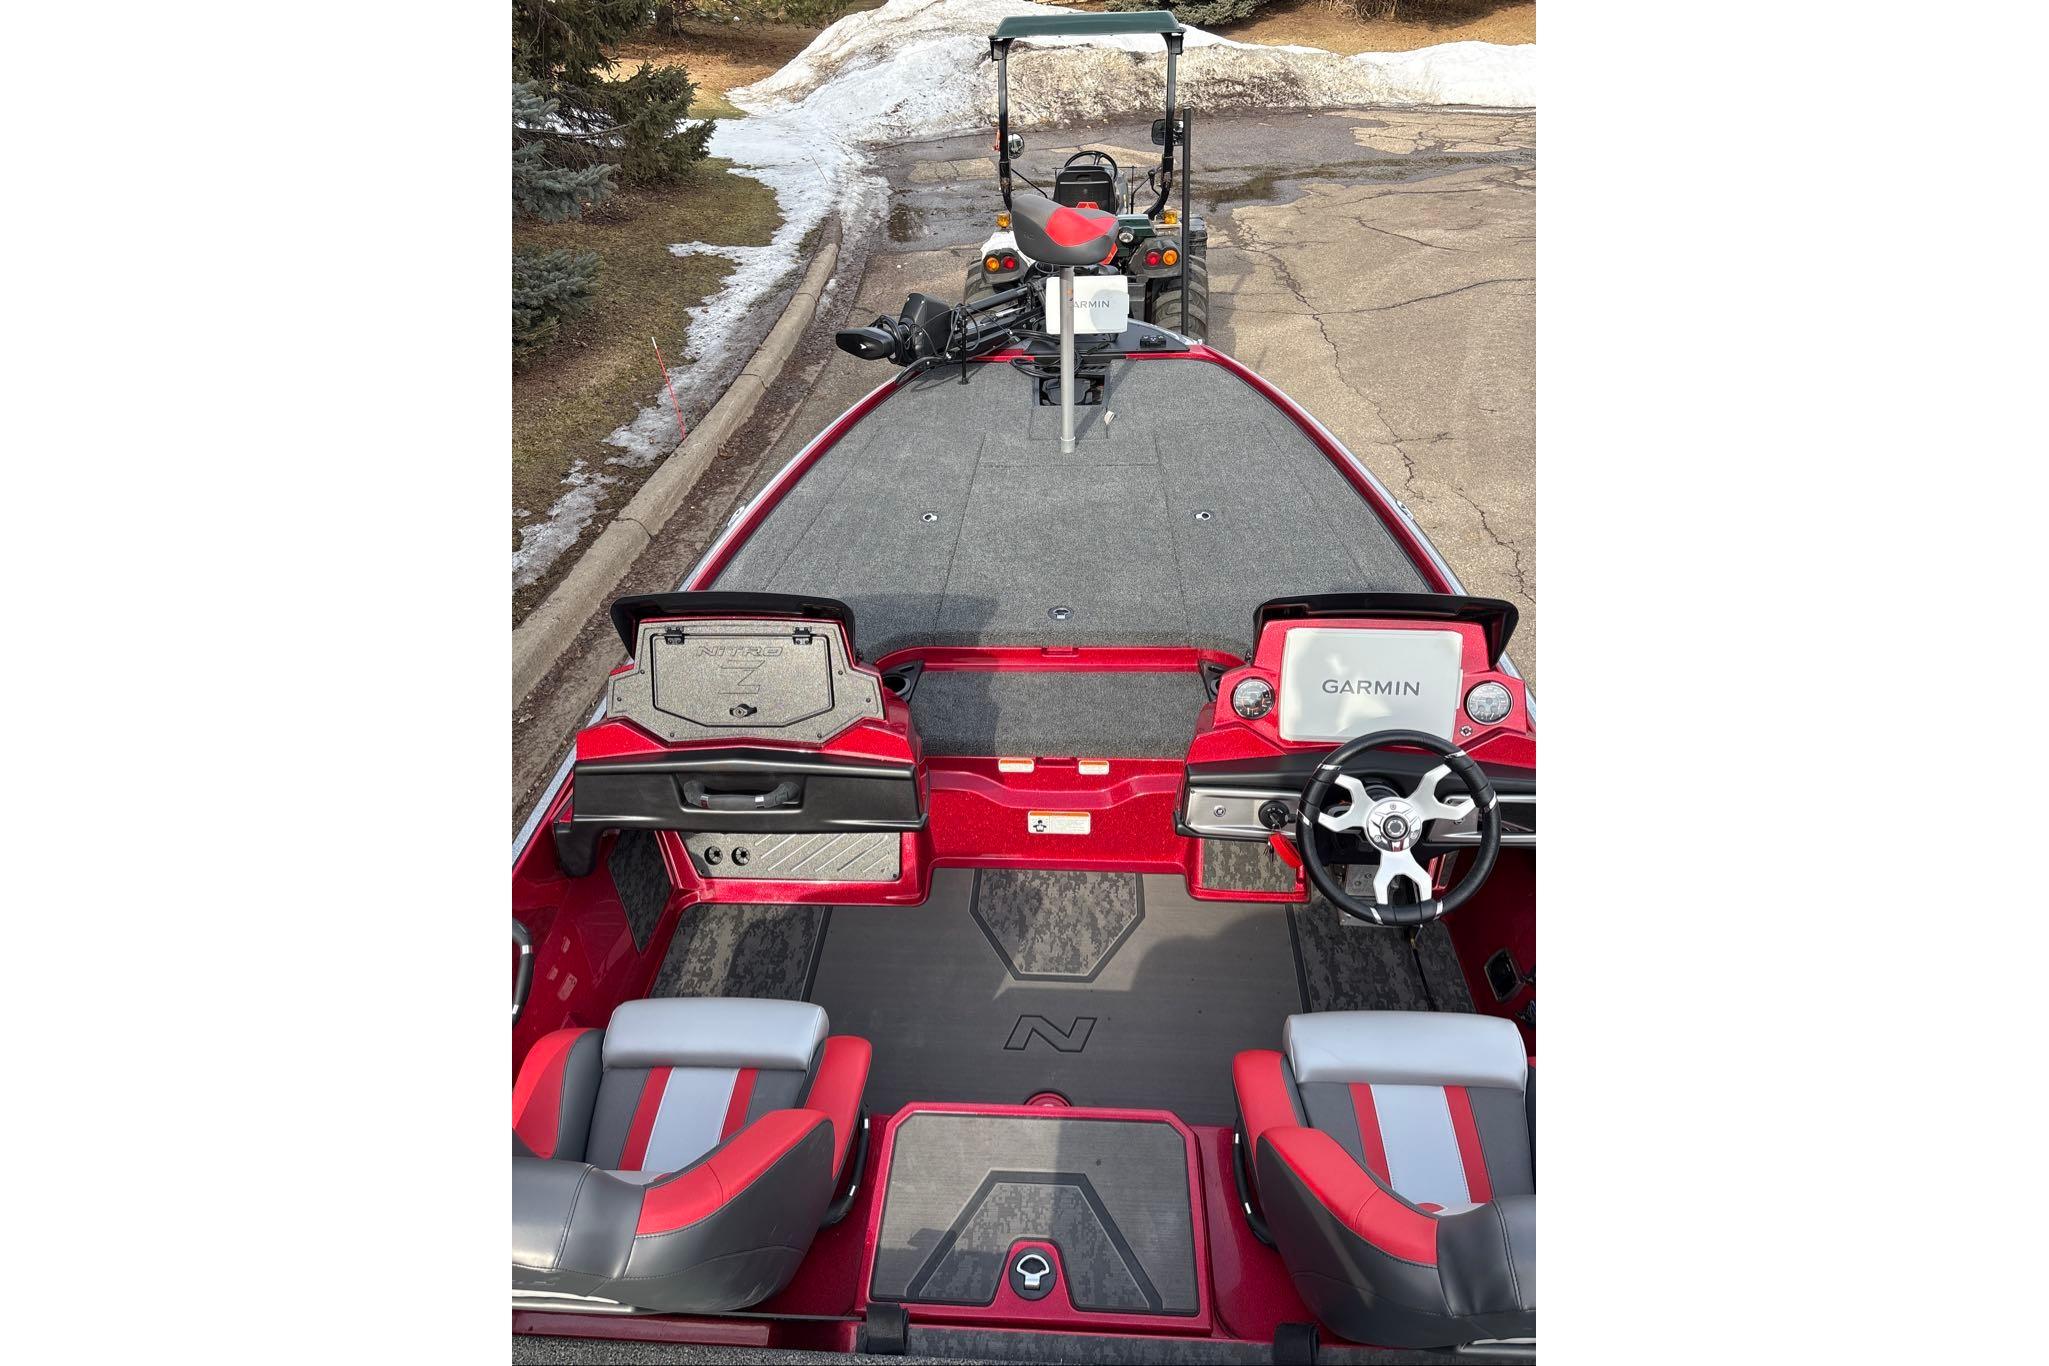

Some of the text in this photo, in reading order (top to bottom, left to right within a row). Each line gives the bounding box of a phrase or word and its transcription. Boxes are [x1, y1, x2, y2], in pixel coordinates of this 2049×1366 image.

[1073, 300, 1110, 309] ARMIN
[1321, 679, 1420, 696] GARMIN
[1003, 1014, 1098, 1053] N
